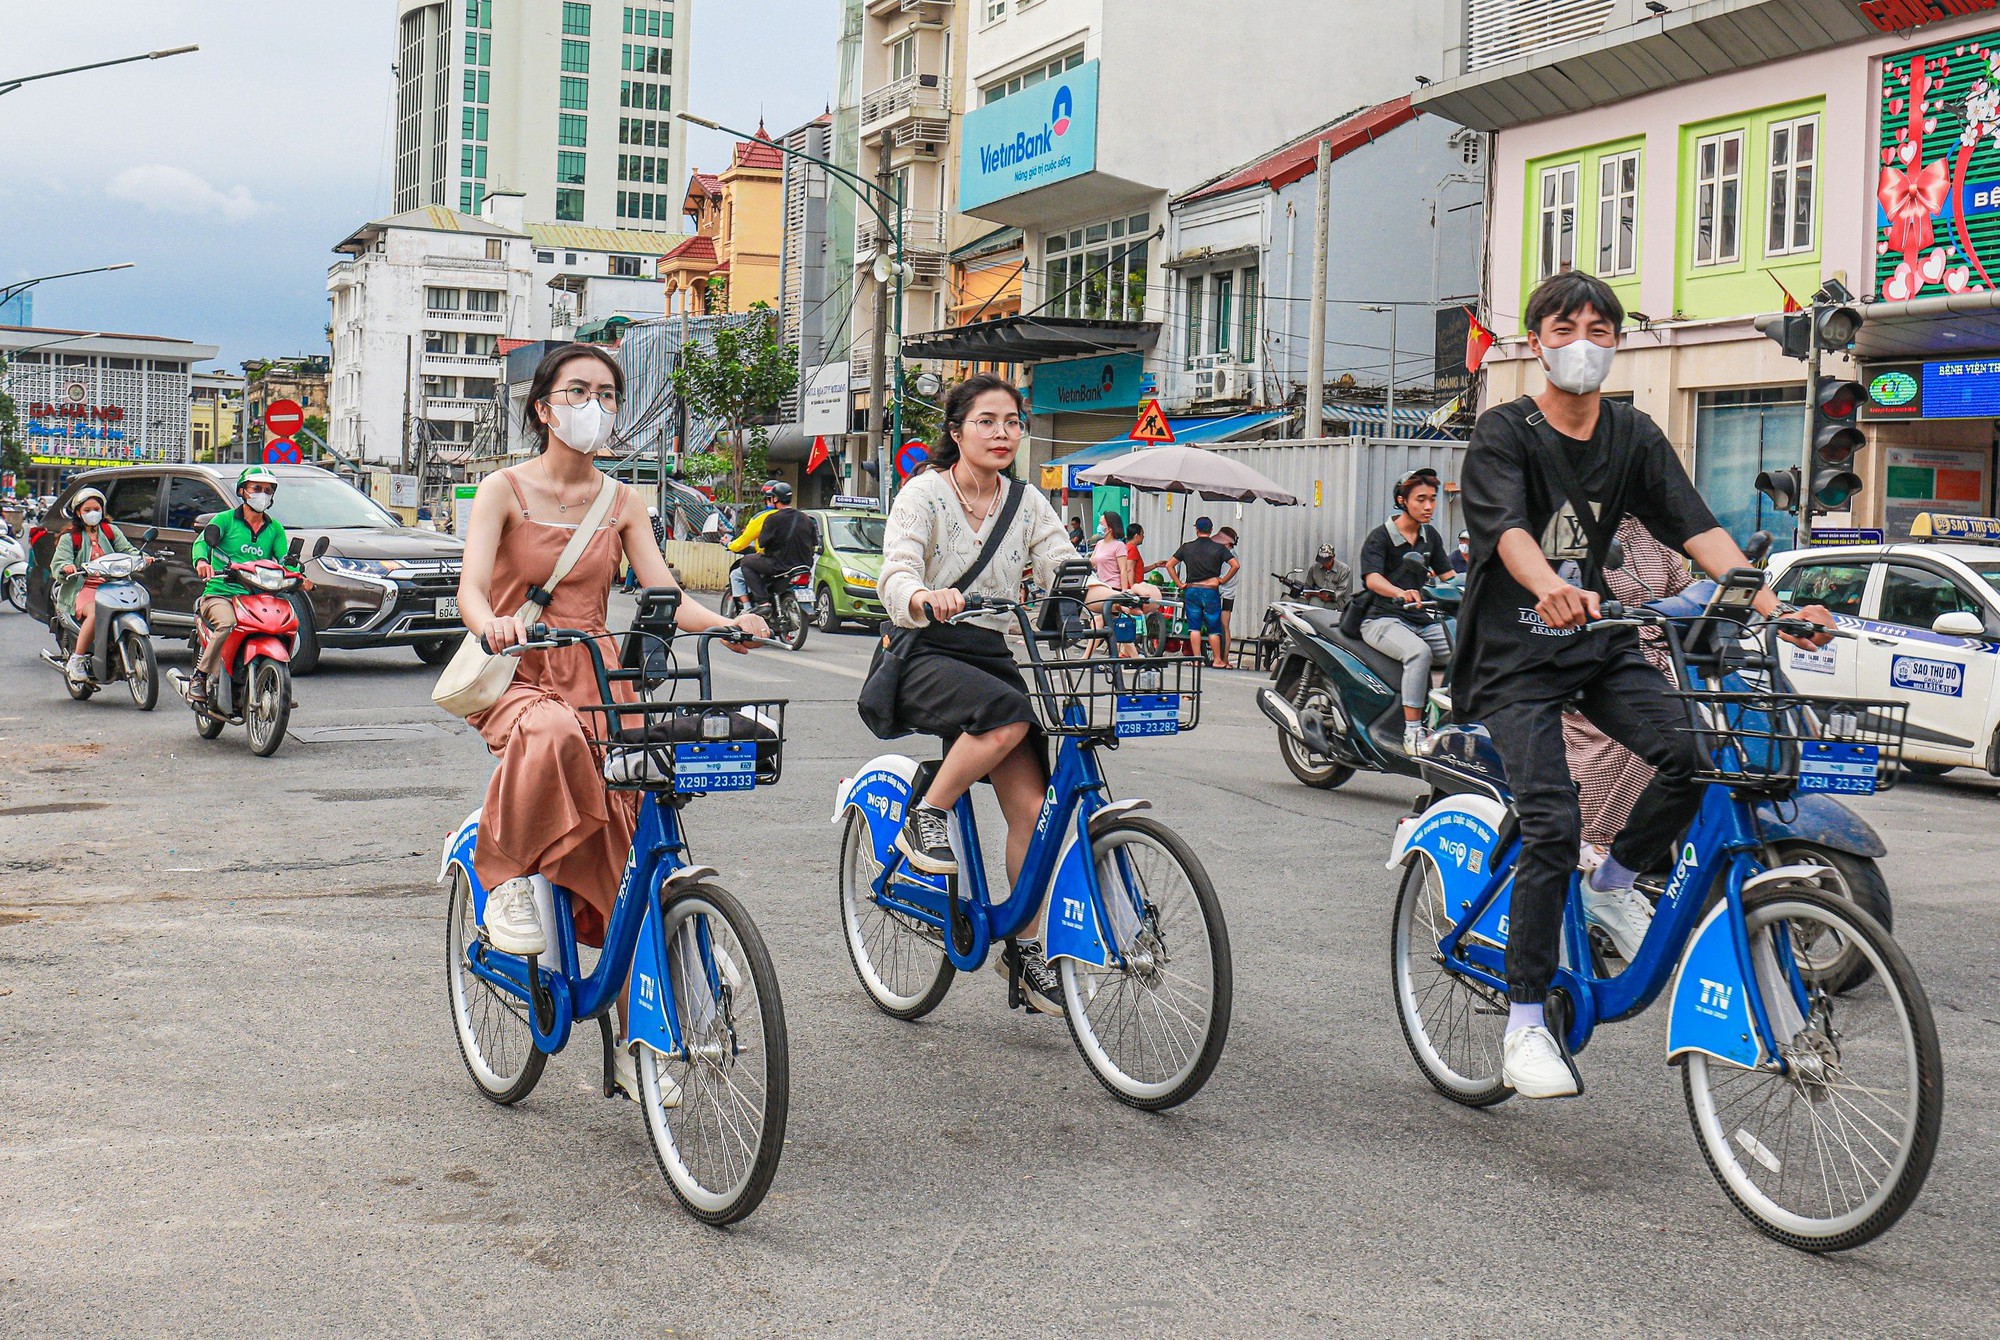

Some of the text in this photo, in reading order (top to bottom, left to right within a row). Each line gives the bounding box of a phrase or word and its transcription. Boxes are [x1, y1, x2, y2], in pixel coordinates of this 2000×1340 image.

[980, 122, 1053, 175] VietinBank
[1058, 382, 1102, 404] VietinBank
[29, 402, 56, 418] GA
[1950, 519, 1969, 531] SAO
[240, 544, 264, 557] Grab
[1913, 662, 1928, 676] SAO
[679, 775, 752, 789] X29D-23.333
[1666, 842, 1699, 900] TNGO
[1063, 897, 1085, 922] TN
[639, 972, 655, 1002] TN
[1699, 978, 1732, 1010] TN
